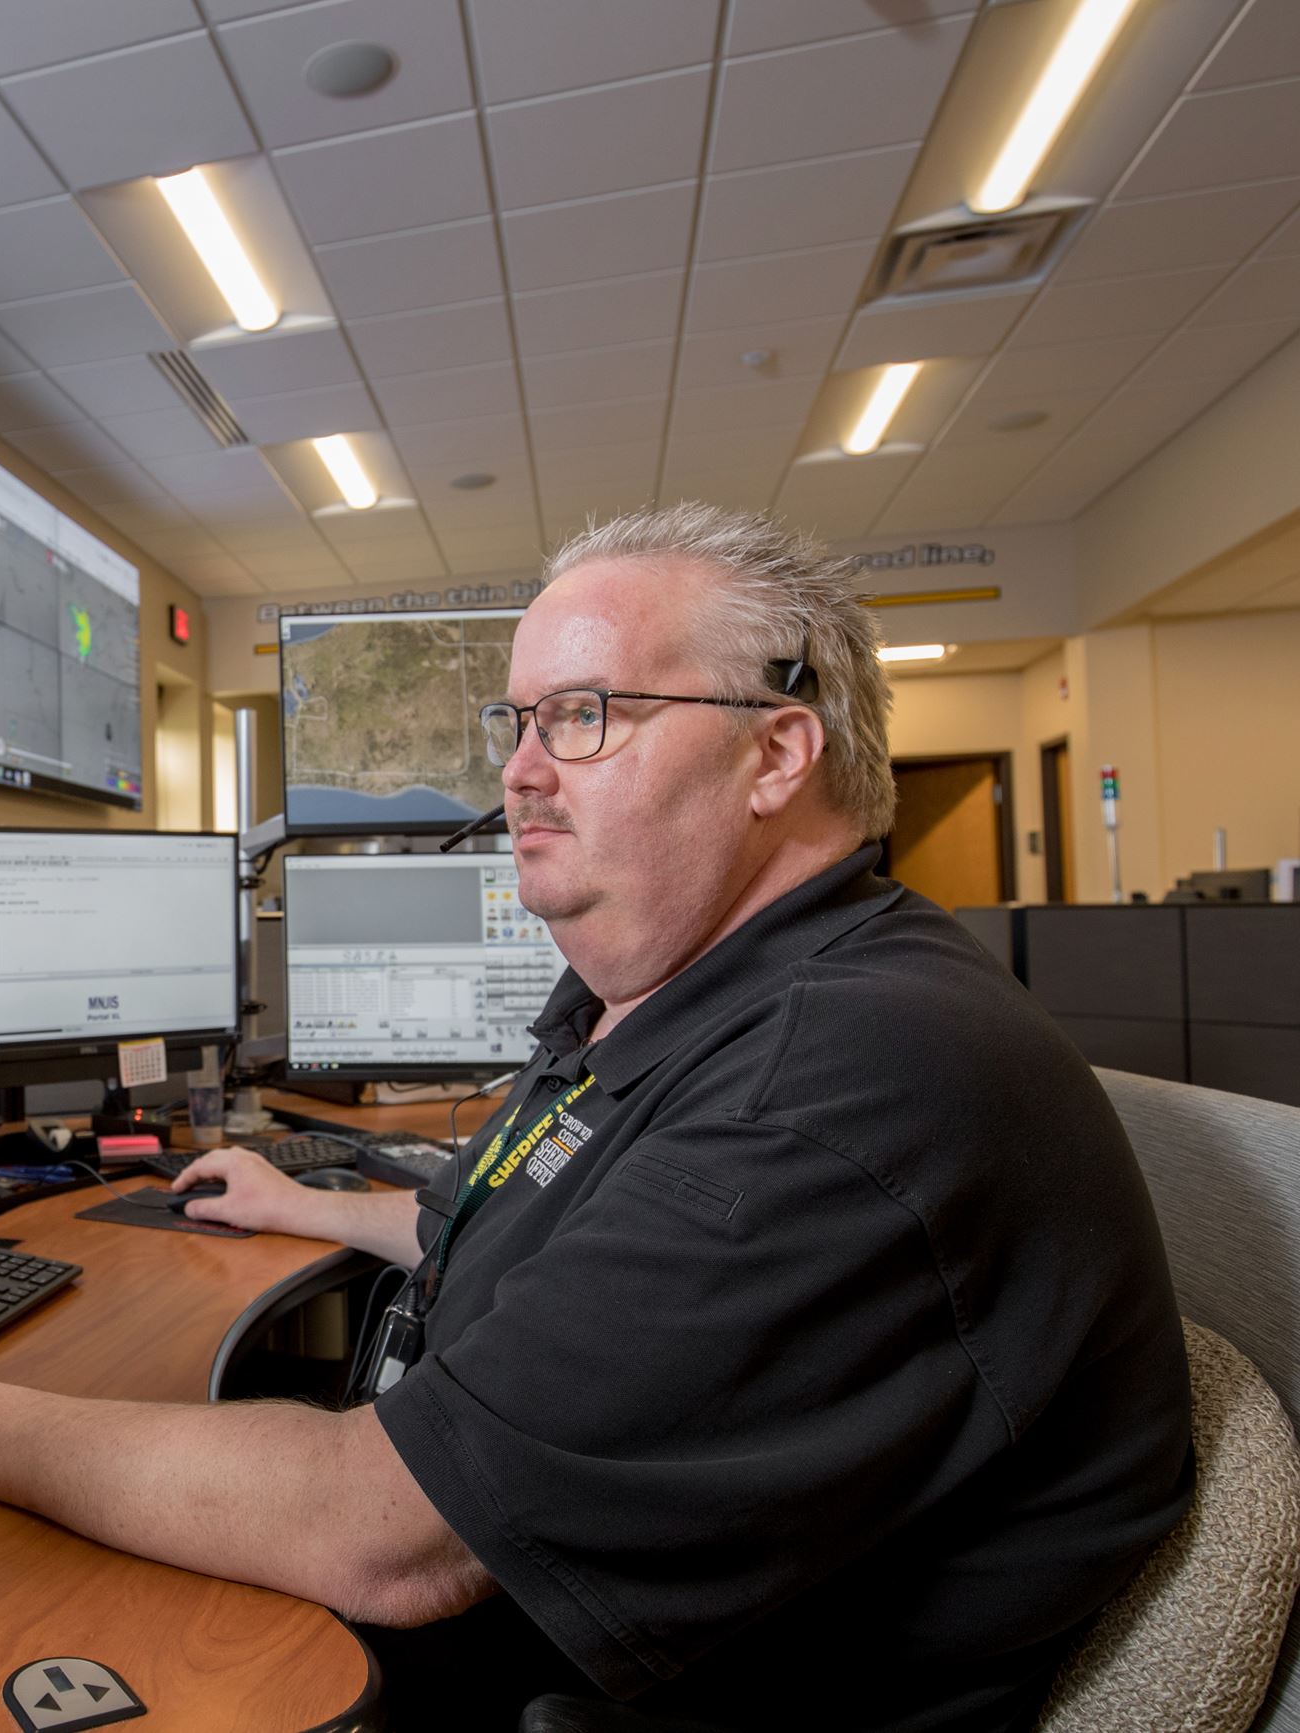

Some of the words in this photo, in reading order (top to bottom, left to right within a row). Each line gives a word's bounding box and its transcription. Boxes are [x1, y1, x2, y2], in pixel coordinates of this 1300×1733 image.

[388, 590, 442, 610] the
[445, 582, 507, 606] thin
[558, 1128, 584, 1152] COUNT
